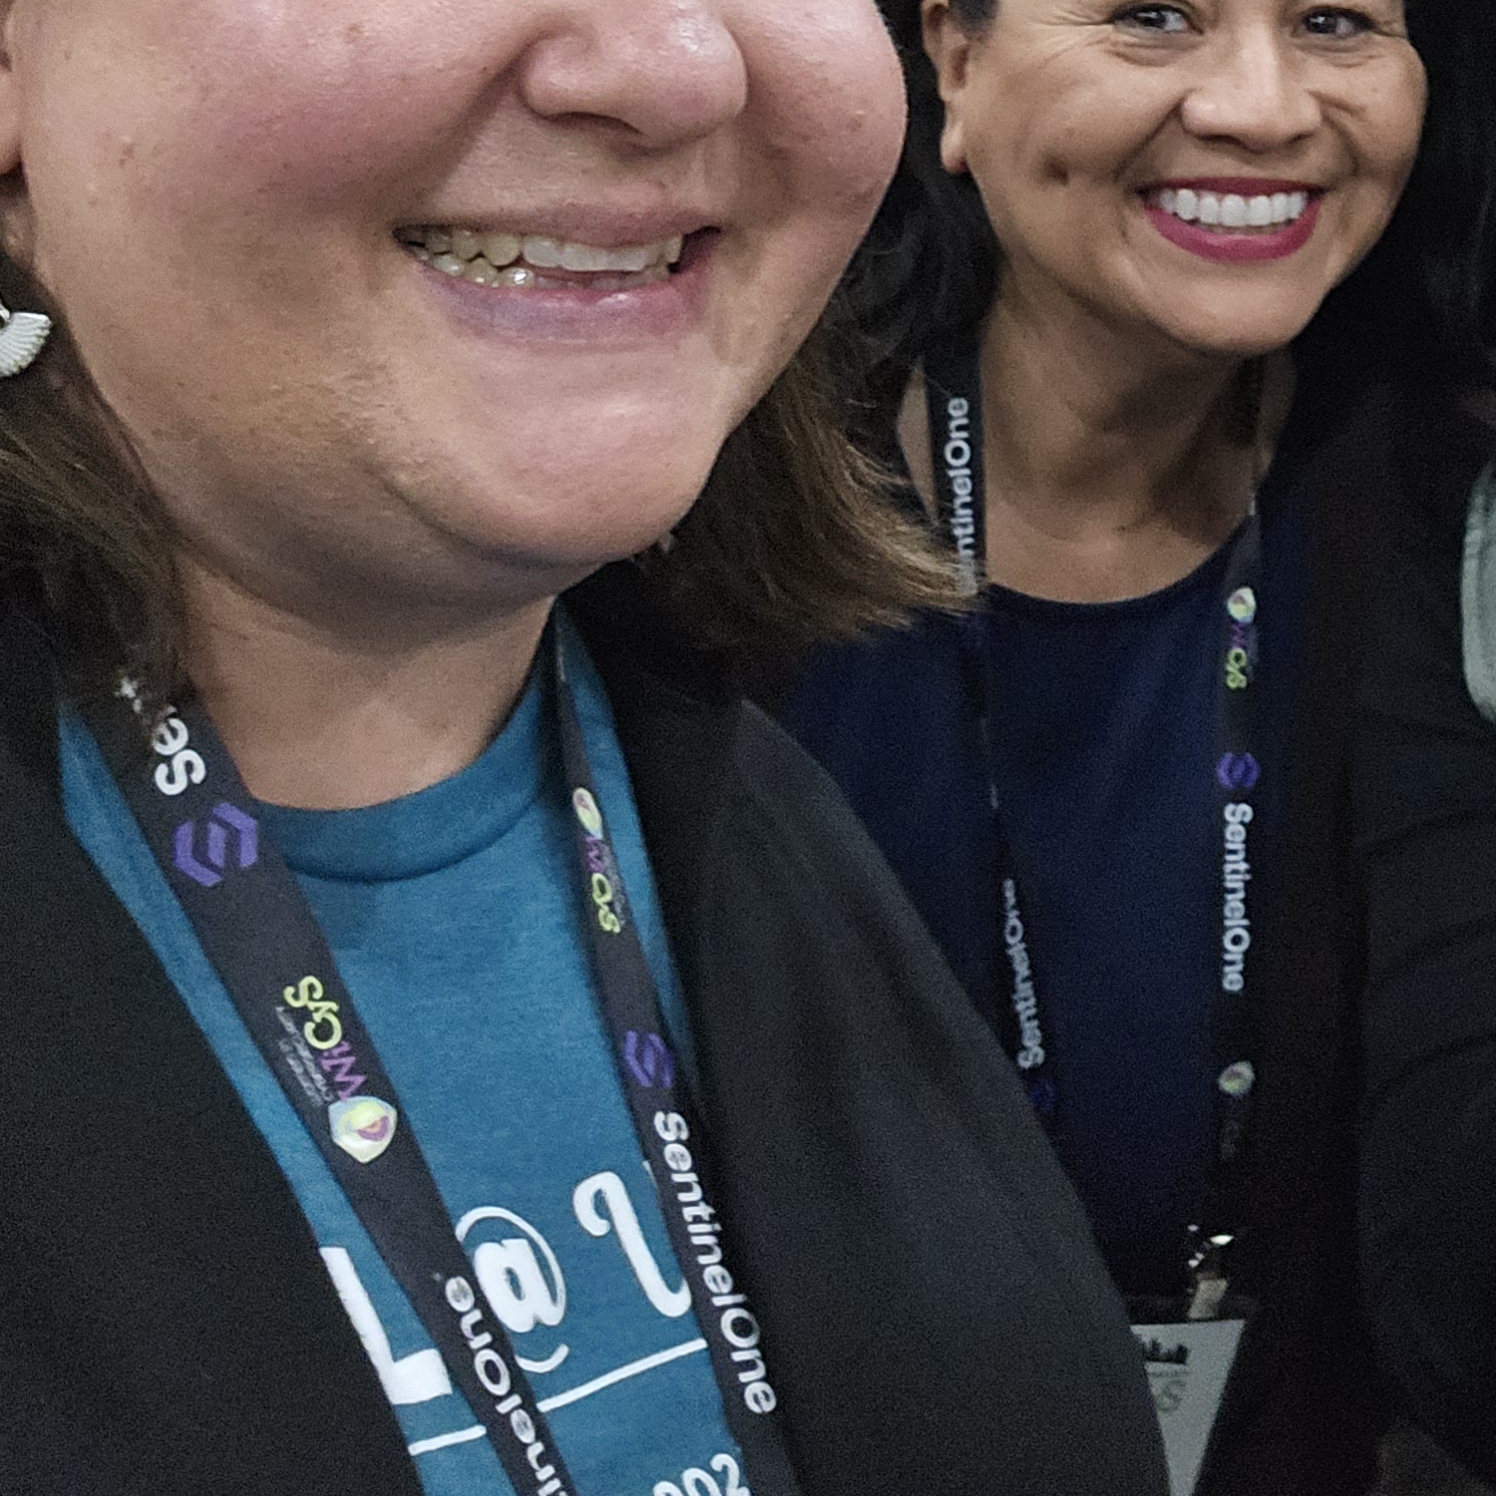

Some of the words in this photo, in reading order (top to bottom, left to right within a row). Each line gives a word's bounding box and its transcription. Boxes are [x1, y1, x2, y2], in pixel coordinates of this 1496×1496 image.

[943, 396, 979, 596] ntinelOne
[1222, 802, 1254, 993] SentinelOne
[282, 974, 368, 1102] WiCyS
[653, 1110, 778, 1415] SentinelOne
[444, 1275, 574, 1496] inelOne
